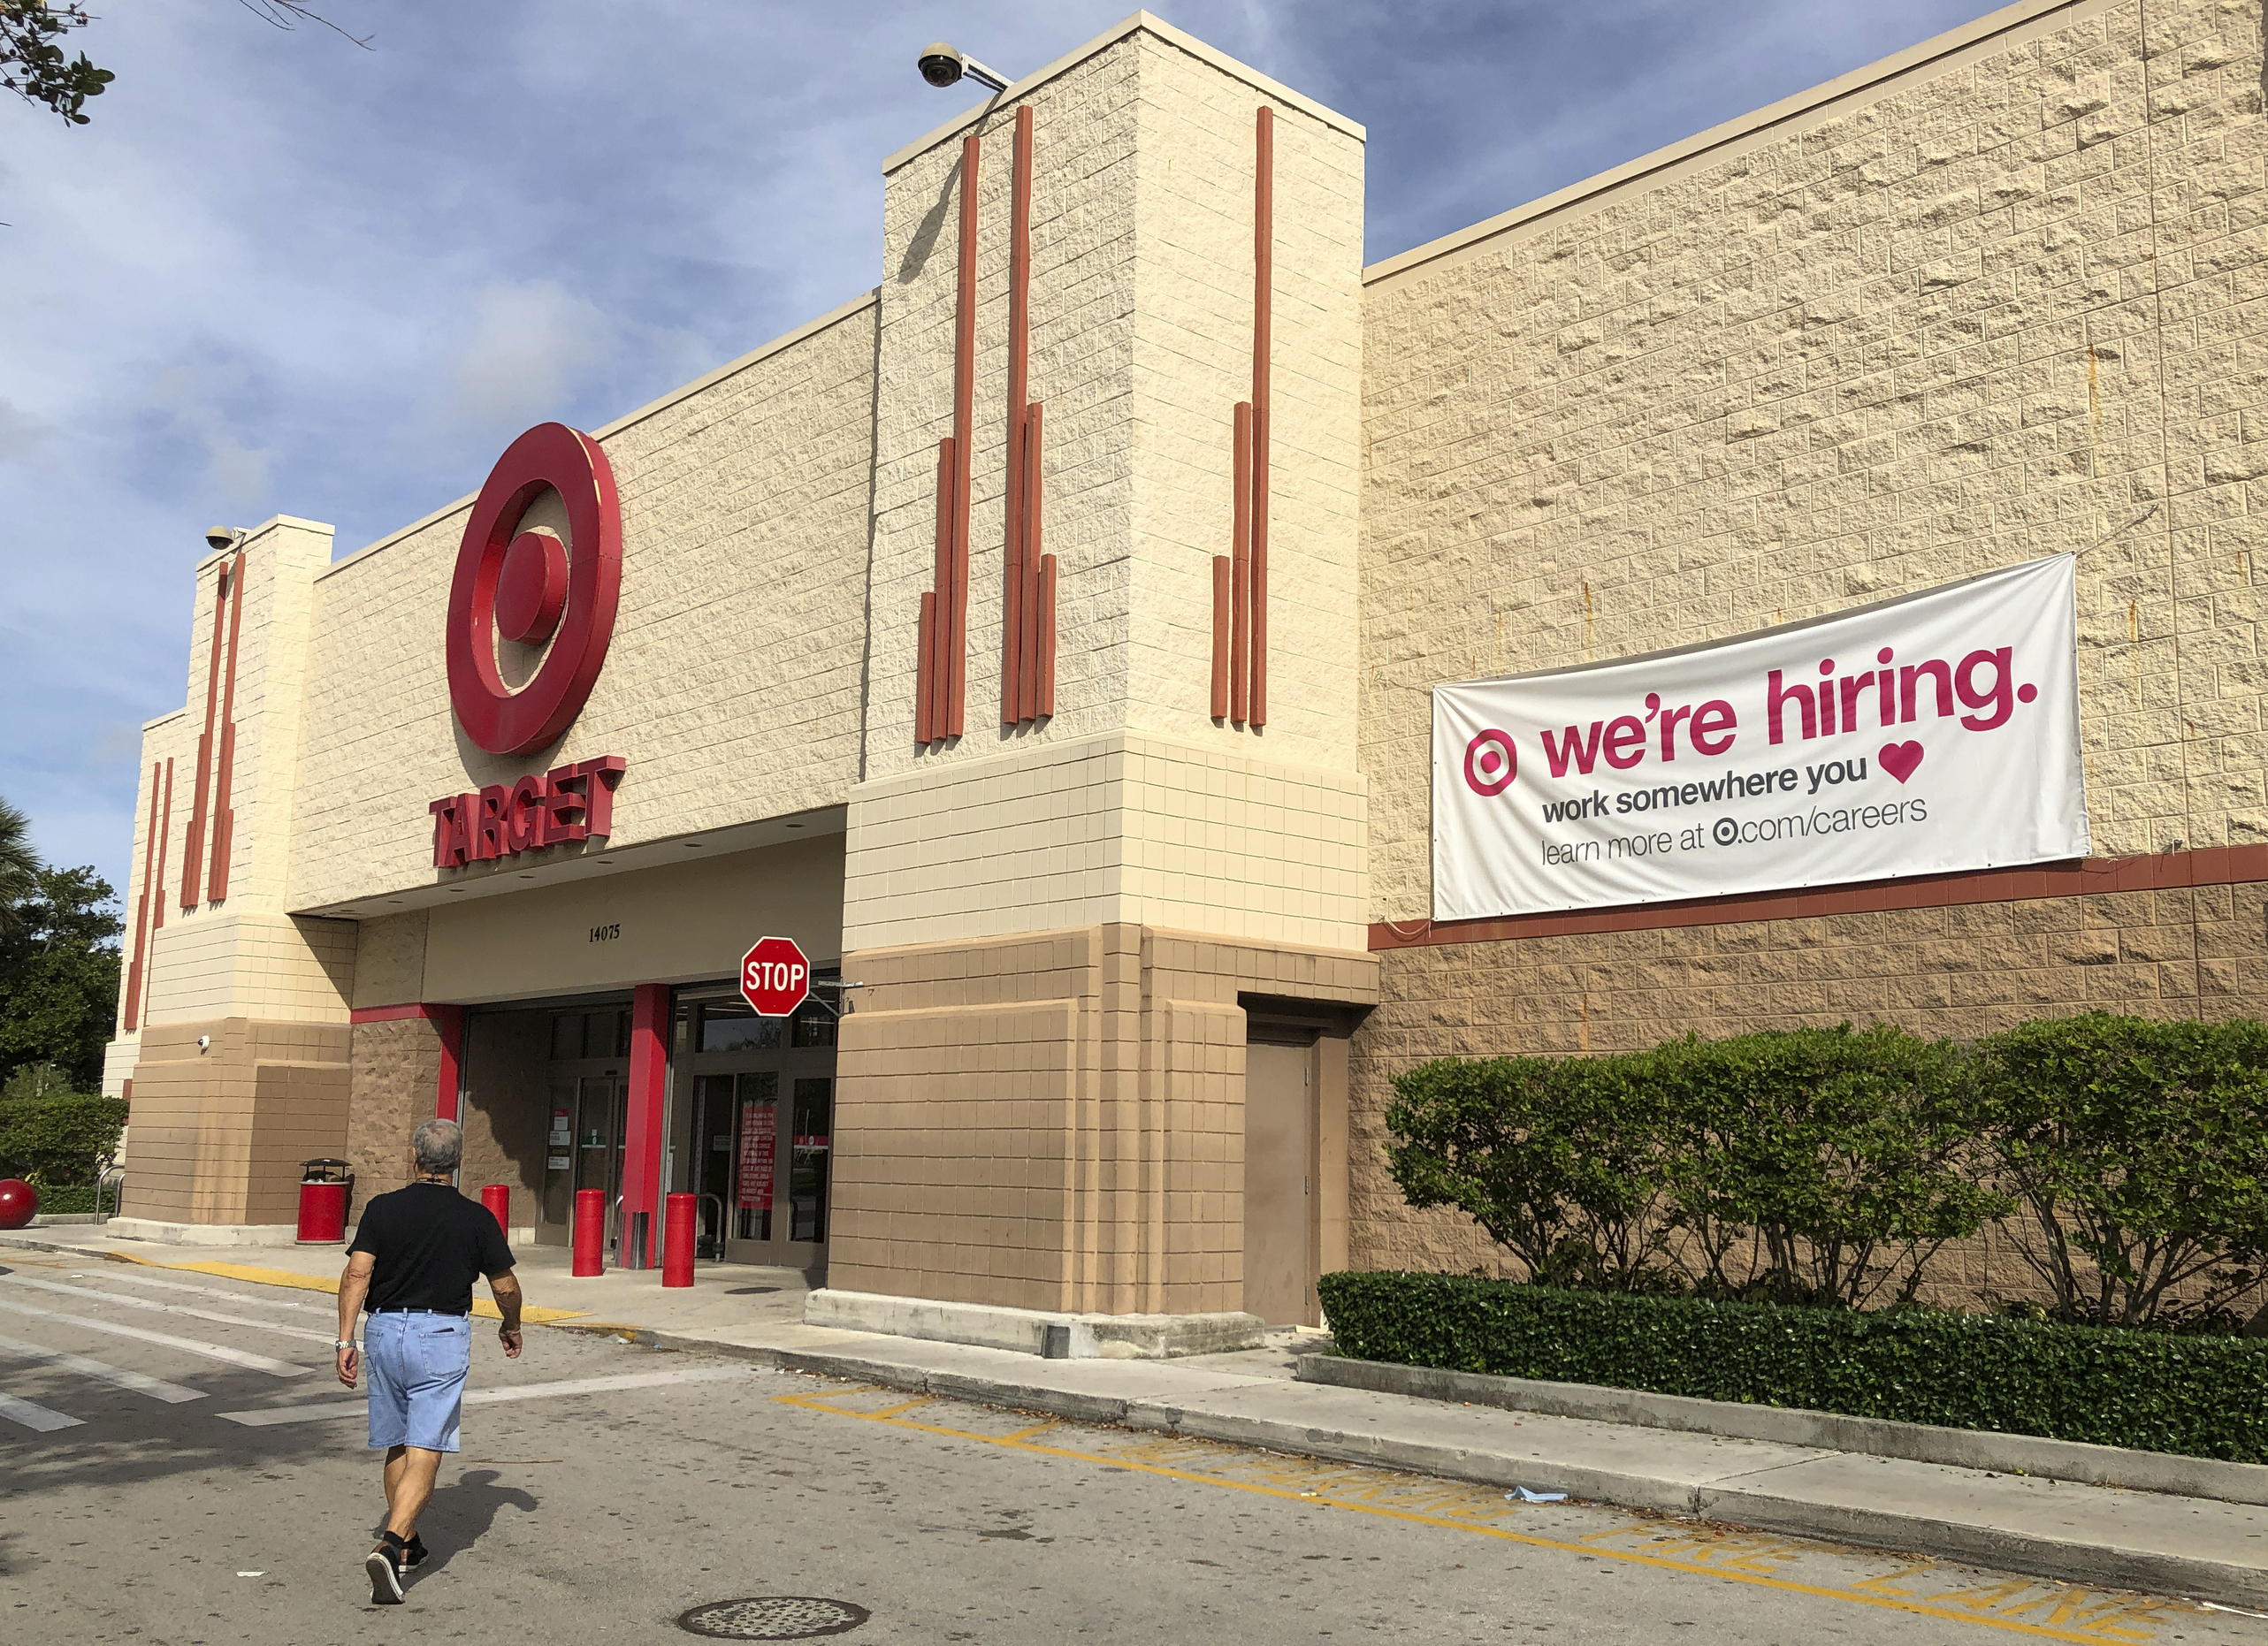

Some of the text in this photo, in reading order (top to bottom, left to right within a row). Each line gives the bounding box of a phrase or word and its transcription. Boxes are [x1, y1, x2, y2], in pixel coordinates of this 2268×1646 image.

[1540, 646, 2038, 778] we’re hiring.
[429, 755, 626, 868] TARGET
[1541, 757, 1867, 823] work somewhere you
[1541, 840, 1600, 865] learn
[1607, 832, 1673, 859] more
[1680, 822, 1705, 850] at
[589, 923, 621, 943] 14075
[745, 961, 805, 992] STOP
[1851, 1563, 2215, 1639] LANE
